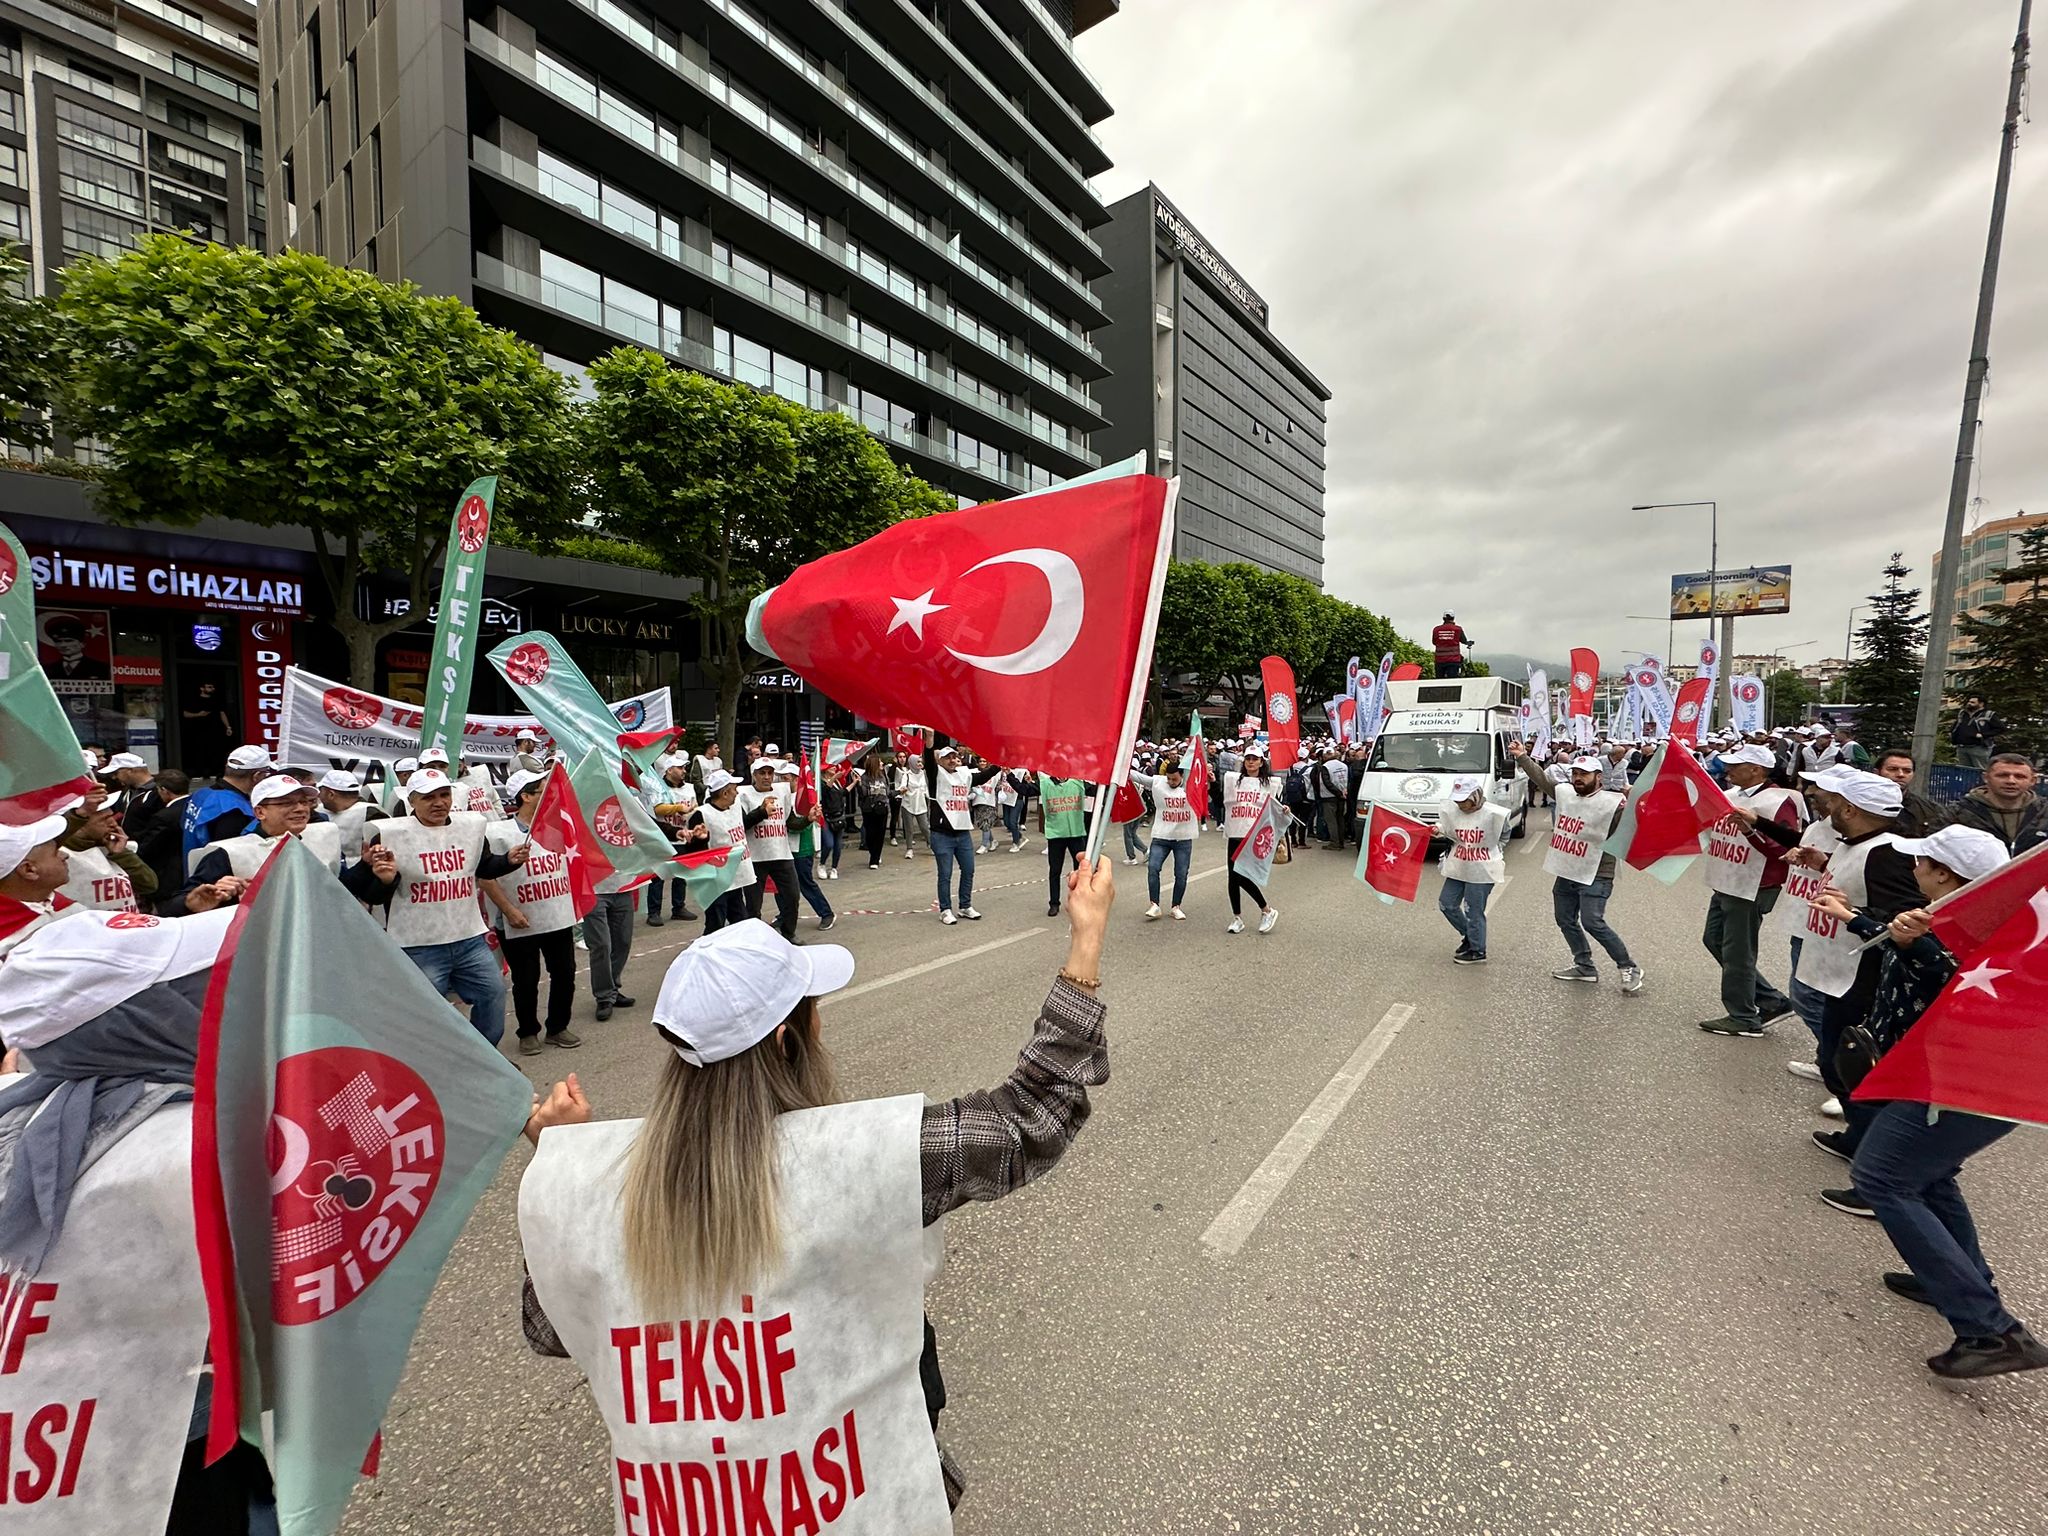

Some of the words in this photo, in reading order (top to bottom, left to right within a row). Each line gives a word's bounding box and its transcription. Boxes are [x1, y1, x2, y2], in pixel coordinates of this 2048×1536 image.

[147, 564, 302, 607] CİHAZLARI
[1685, 574, 1711, 584] Good
[1713, 570, 1760, 582] morning!
[561, 612, 628, 636] LUCKY
[635, 620, 672, 640] ART
[431, 565, 474, 750] TEKSİF
[743, 673, 777, 689] eyaz
[391, 707, 487, 736] TEİF
[324, 732, 374, 747] TÜRKİYE
[470, 786, 486, 801] KSİF
[1164, 796, 1187, 809] TEKSİF
[1235, 789, 1261, 804] TEKSİF
[596, 813, 636, 846] TEKSİF
[1162, 809, 1191, 824] SENDİKASI
[1557, 815, 1585, 836] EKSİF
[1454, 826, 1485, 845] TEKSİF
[1549, 833, 1589, 858] NDİKASI
[418, 845, 466, 875] TEKSİF
[525, 850, 563, 877] TEKSİF
[1708, 837, 1750, 865] NDİKASI
[611, 1295, 796, 1424] TEKSİF
[616, 1409, 865, 1536] ENDİKASI
